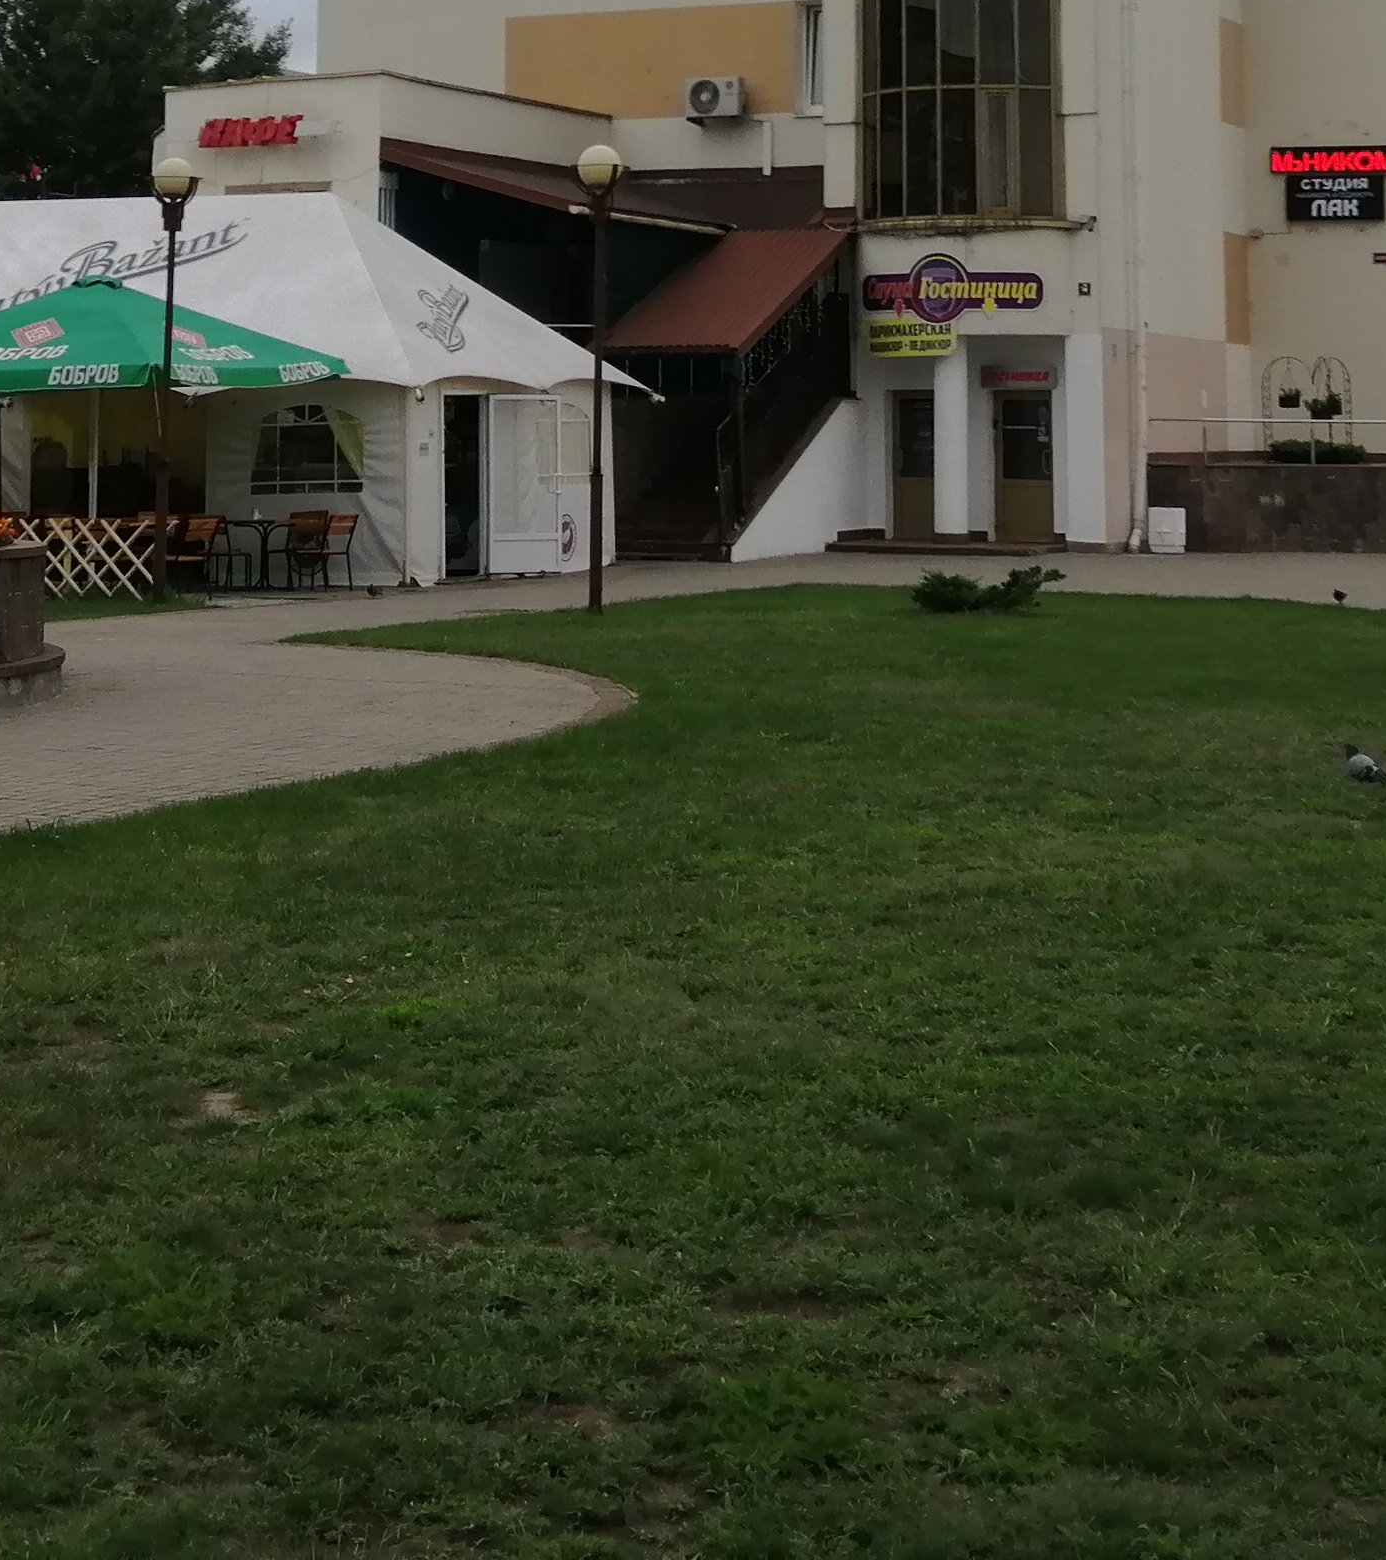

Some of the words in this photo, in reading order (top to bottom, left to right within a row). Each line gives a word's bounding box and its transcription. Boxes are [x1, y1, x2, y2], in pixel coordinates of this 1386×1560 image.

[198, 114, 304, 148] КАФЕ
[918, 276, 1039, 304] Гостиница
[47, 363, 120, 386] БОБРОВ
[278, 361, 331, 384] БОБРОВ
